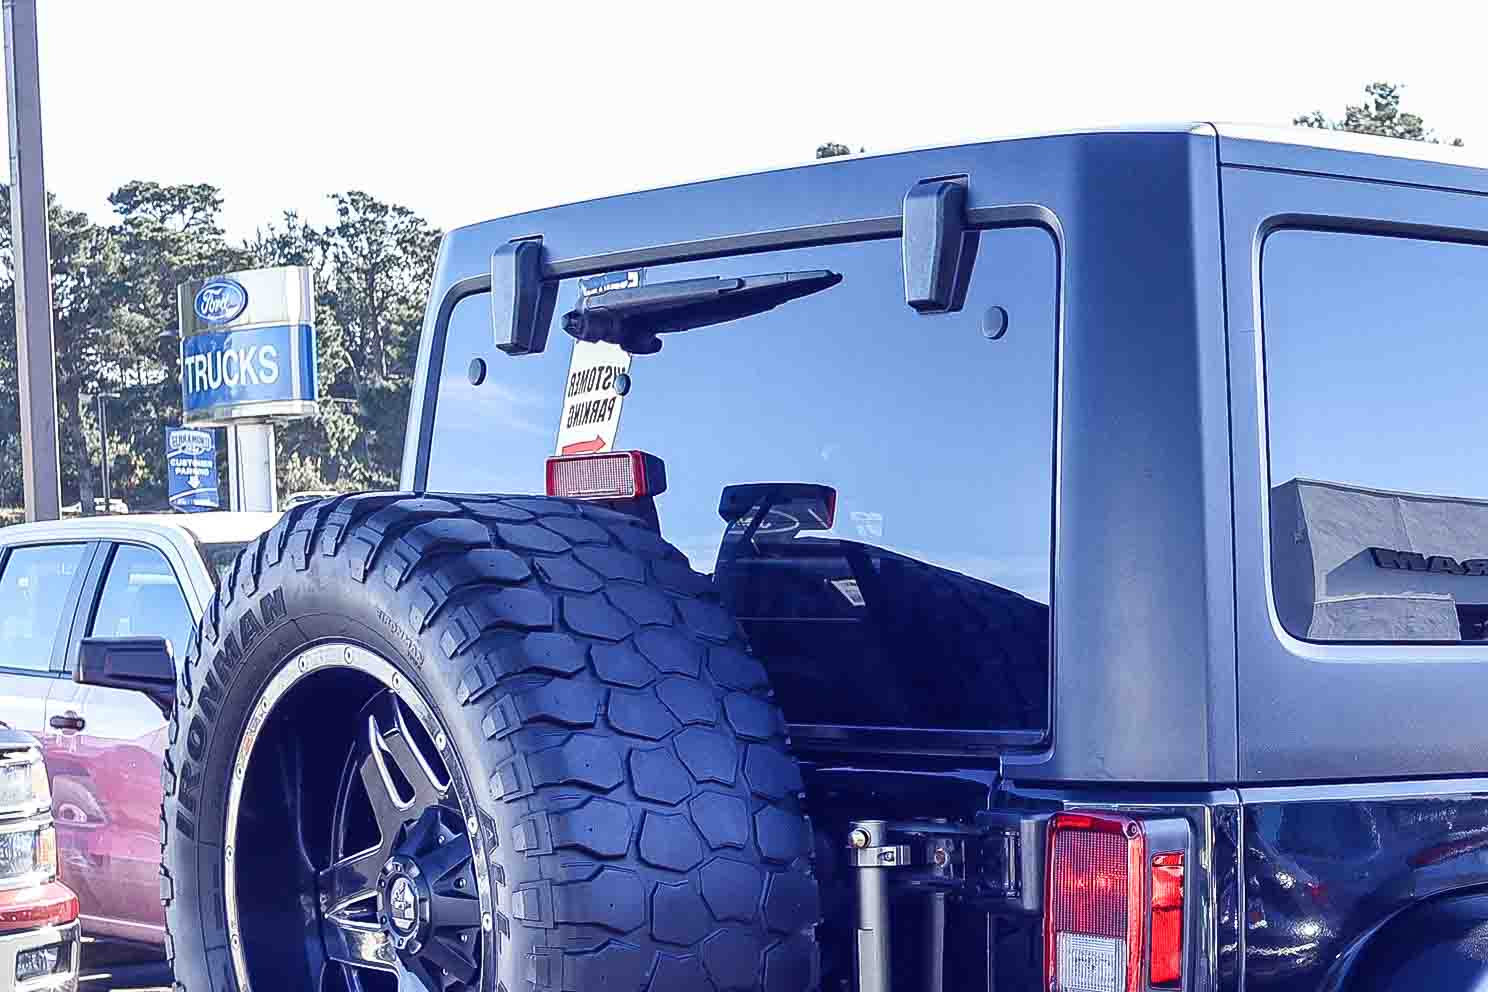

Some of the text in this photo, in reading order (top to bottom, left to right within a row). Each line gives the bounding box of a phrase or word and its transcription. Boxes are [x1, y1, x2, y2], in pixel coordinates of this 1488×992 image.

[200, 287, 236, 315] Ford
[184, 344, 280, 394] TRUCKS
[176, 585, 288, 841] IRONMAN
